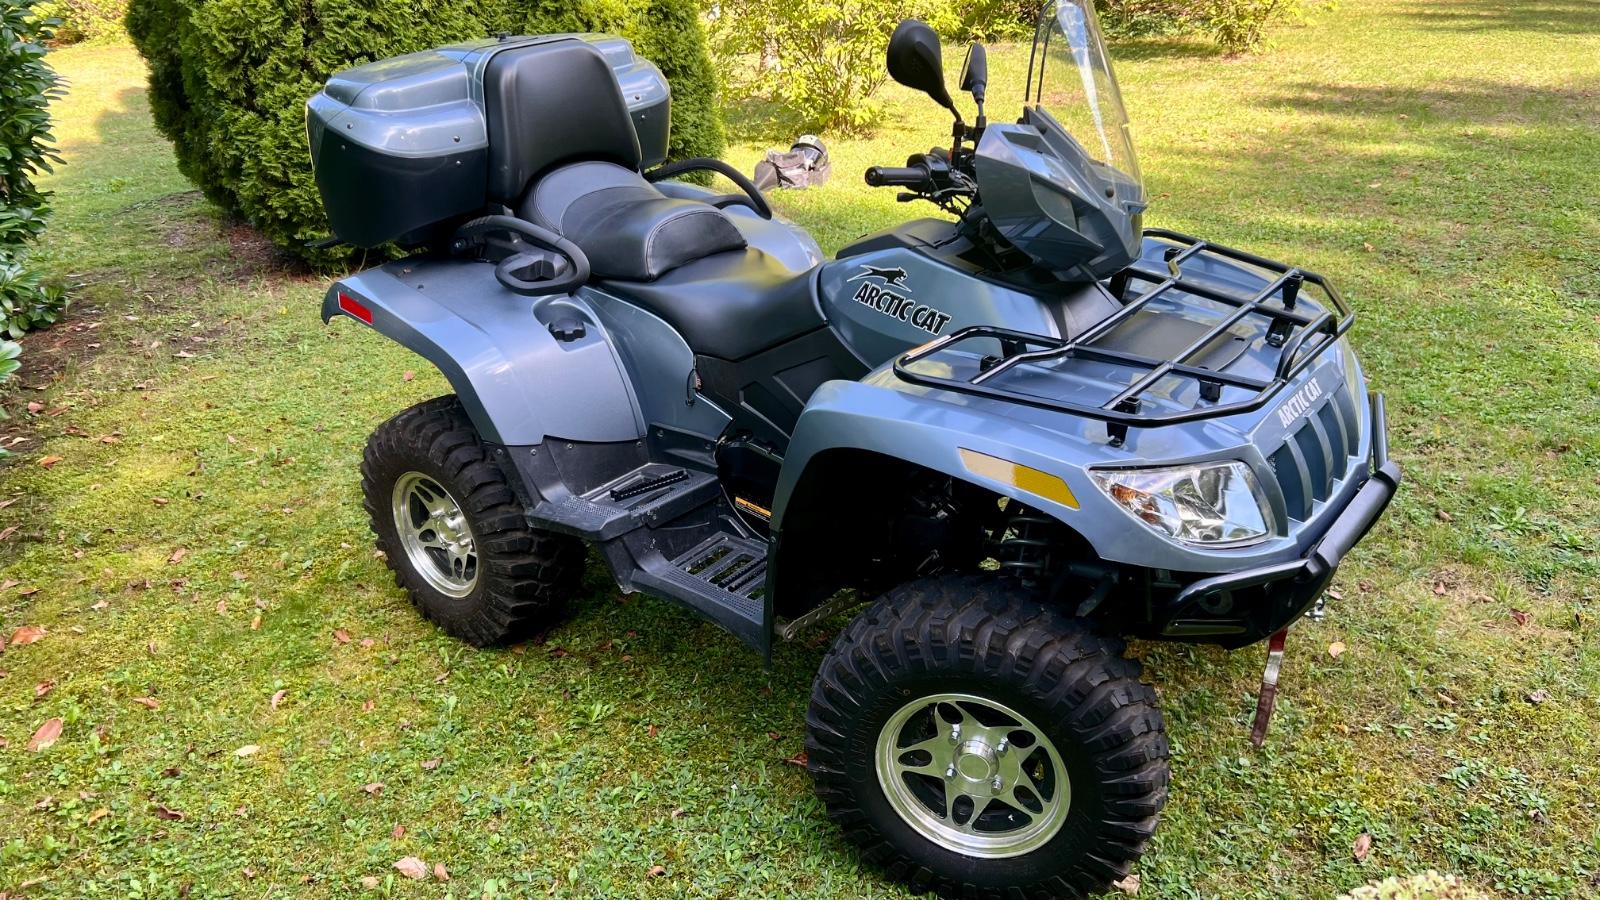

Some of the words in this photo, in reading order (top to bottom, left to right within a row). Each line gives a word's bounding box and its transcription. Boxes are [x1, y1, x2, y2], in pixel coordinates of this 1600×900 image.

[853, 281, 915, 322] ARCTIC
[911, 305, 952, 335] CAT
[1278, 390, 1310, 428] ARCTIC
[1304, 377, 1322, 401] CAT
